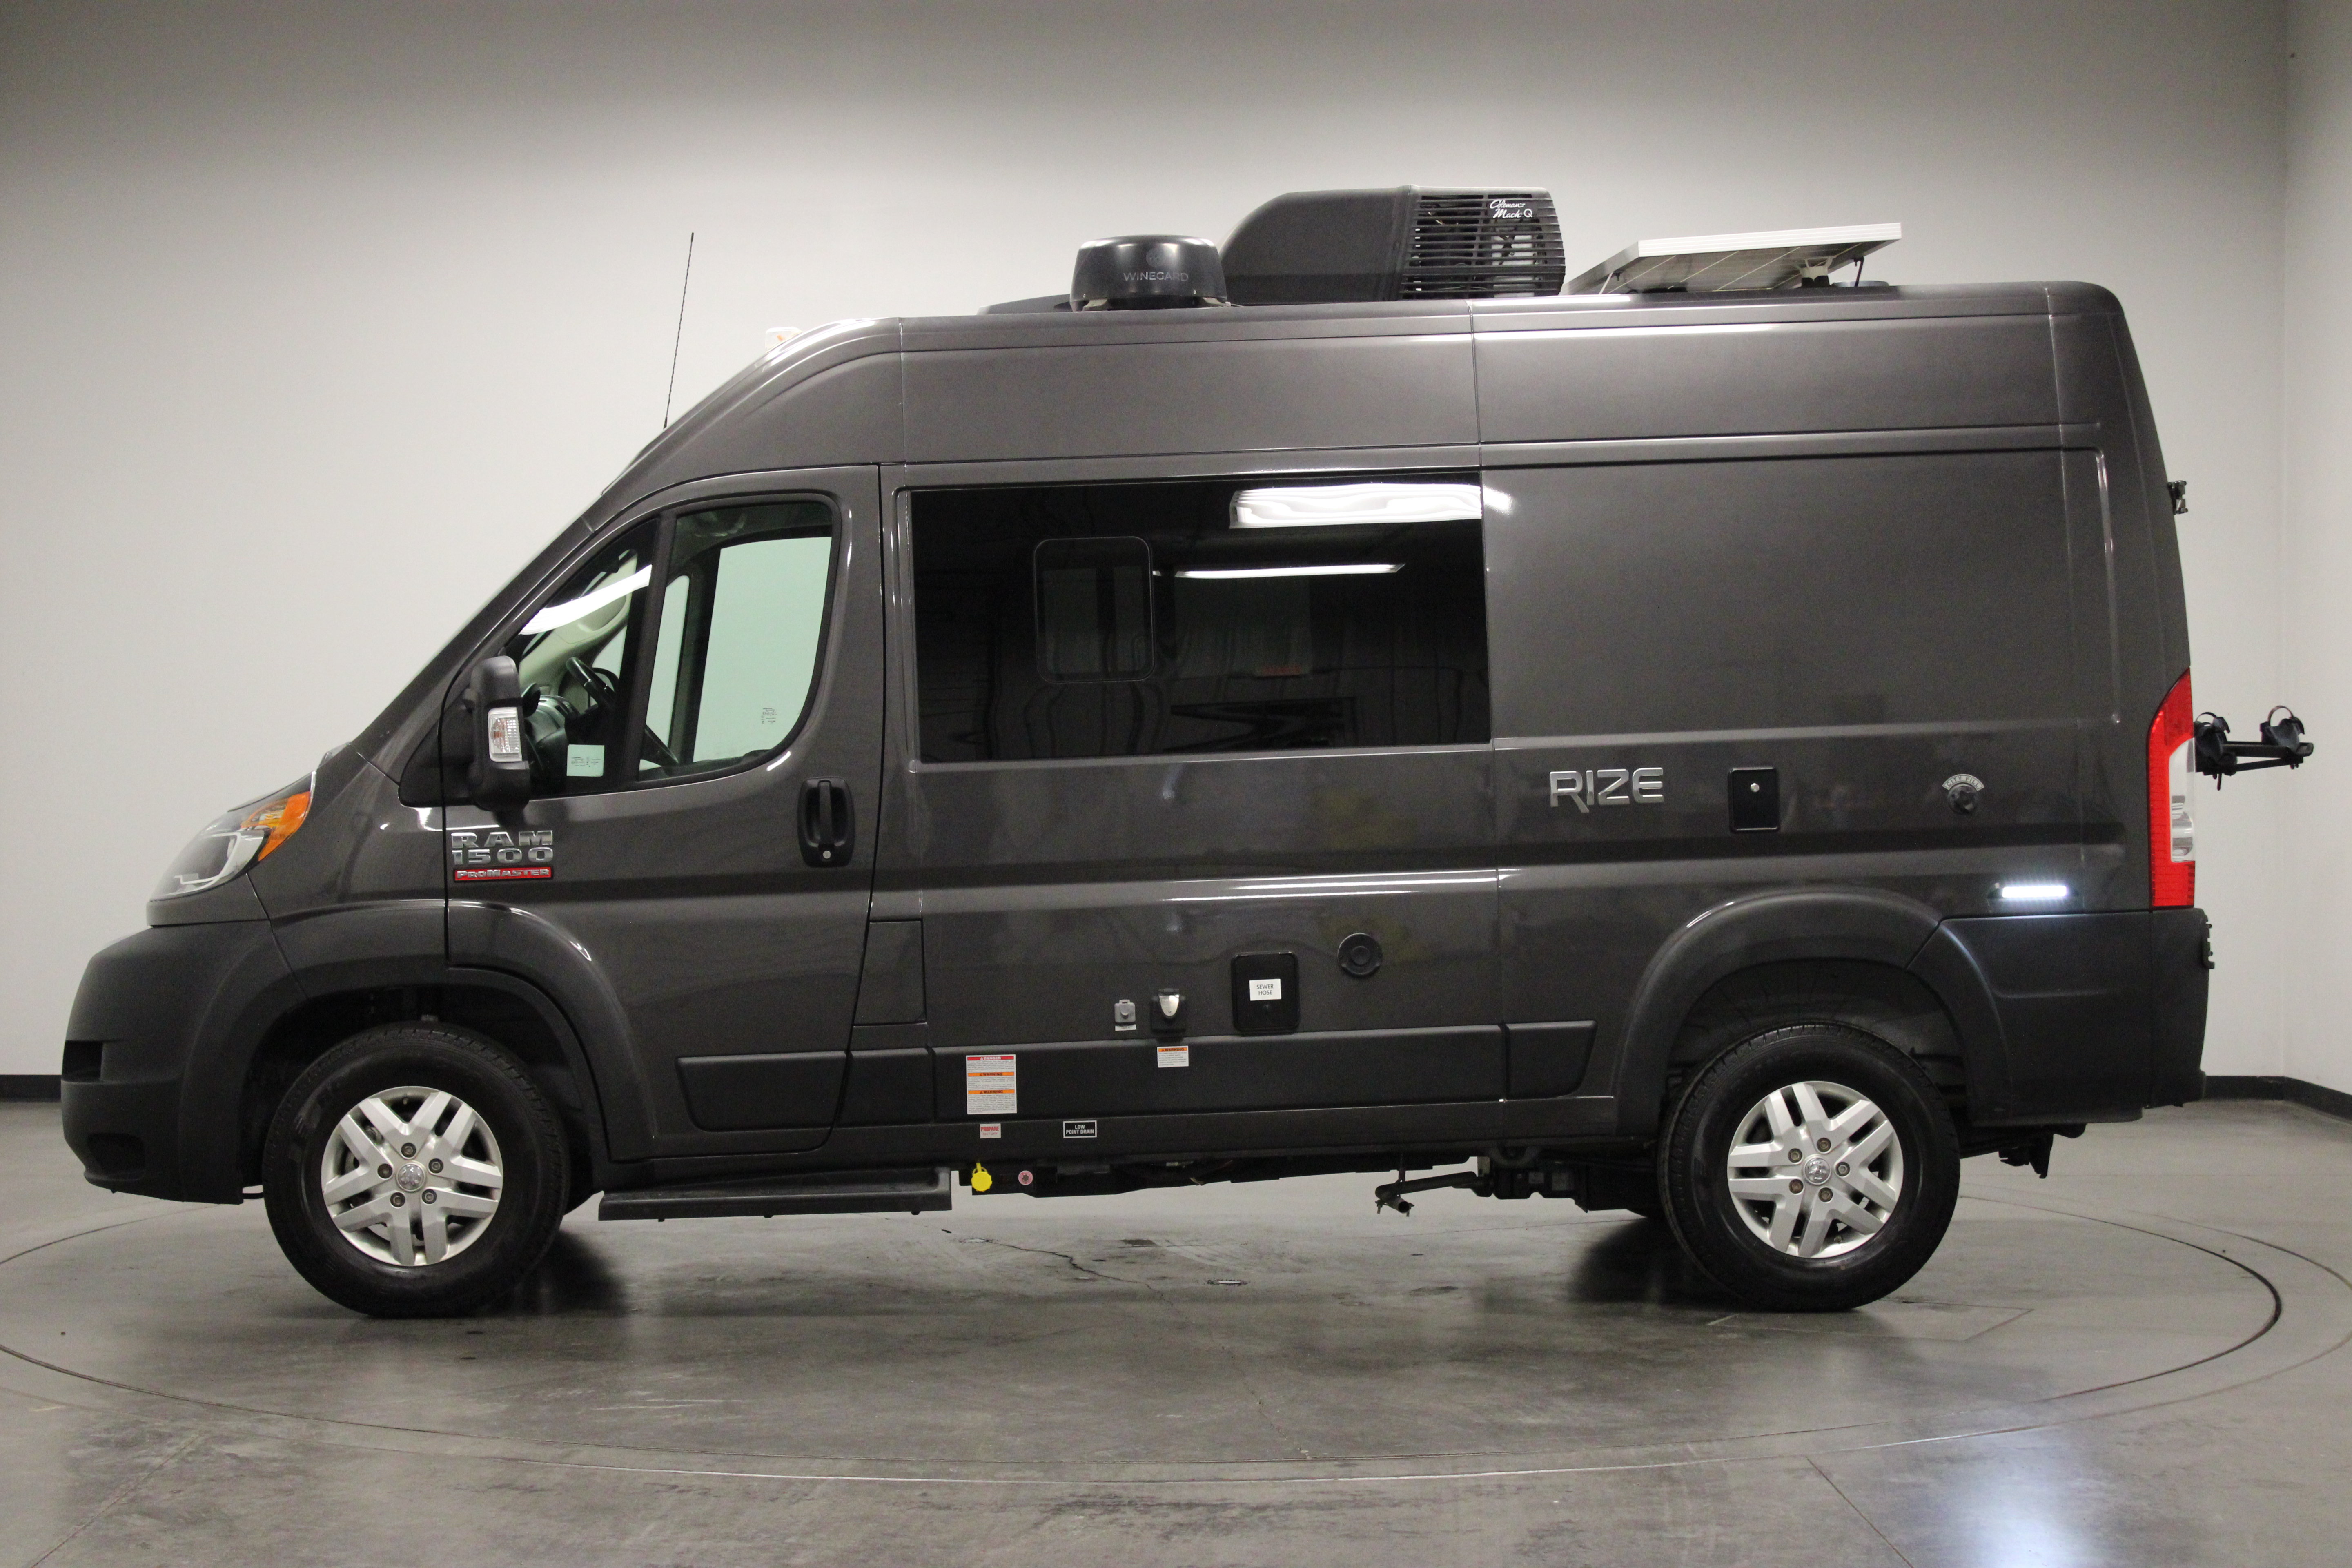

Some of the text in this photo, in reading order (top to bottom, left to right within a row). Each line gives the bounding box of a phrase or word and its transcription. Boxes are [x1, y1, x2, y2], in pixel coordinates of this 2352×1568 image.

[1490, 199, 1525, 209] Coleman
[1493, 208, 1533, 218] Mach Q
[1123, 272, 1189, 281] WINEGARD
[1946, 776, 1980, 787] CITY FILL
[1549, 767, 1664, 813] RIZE
[451, 830, 553, 848] RAM
[452, 846, 554, 865] 1500
